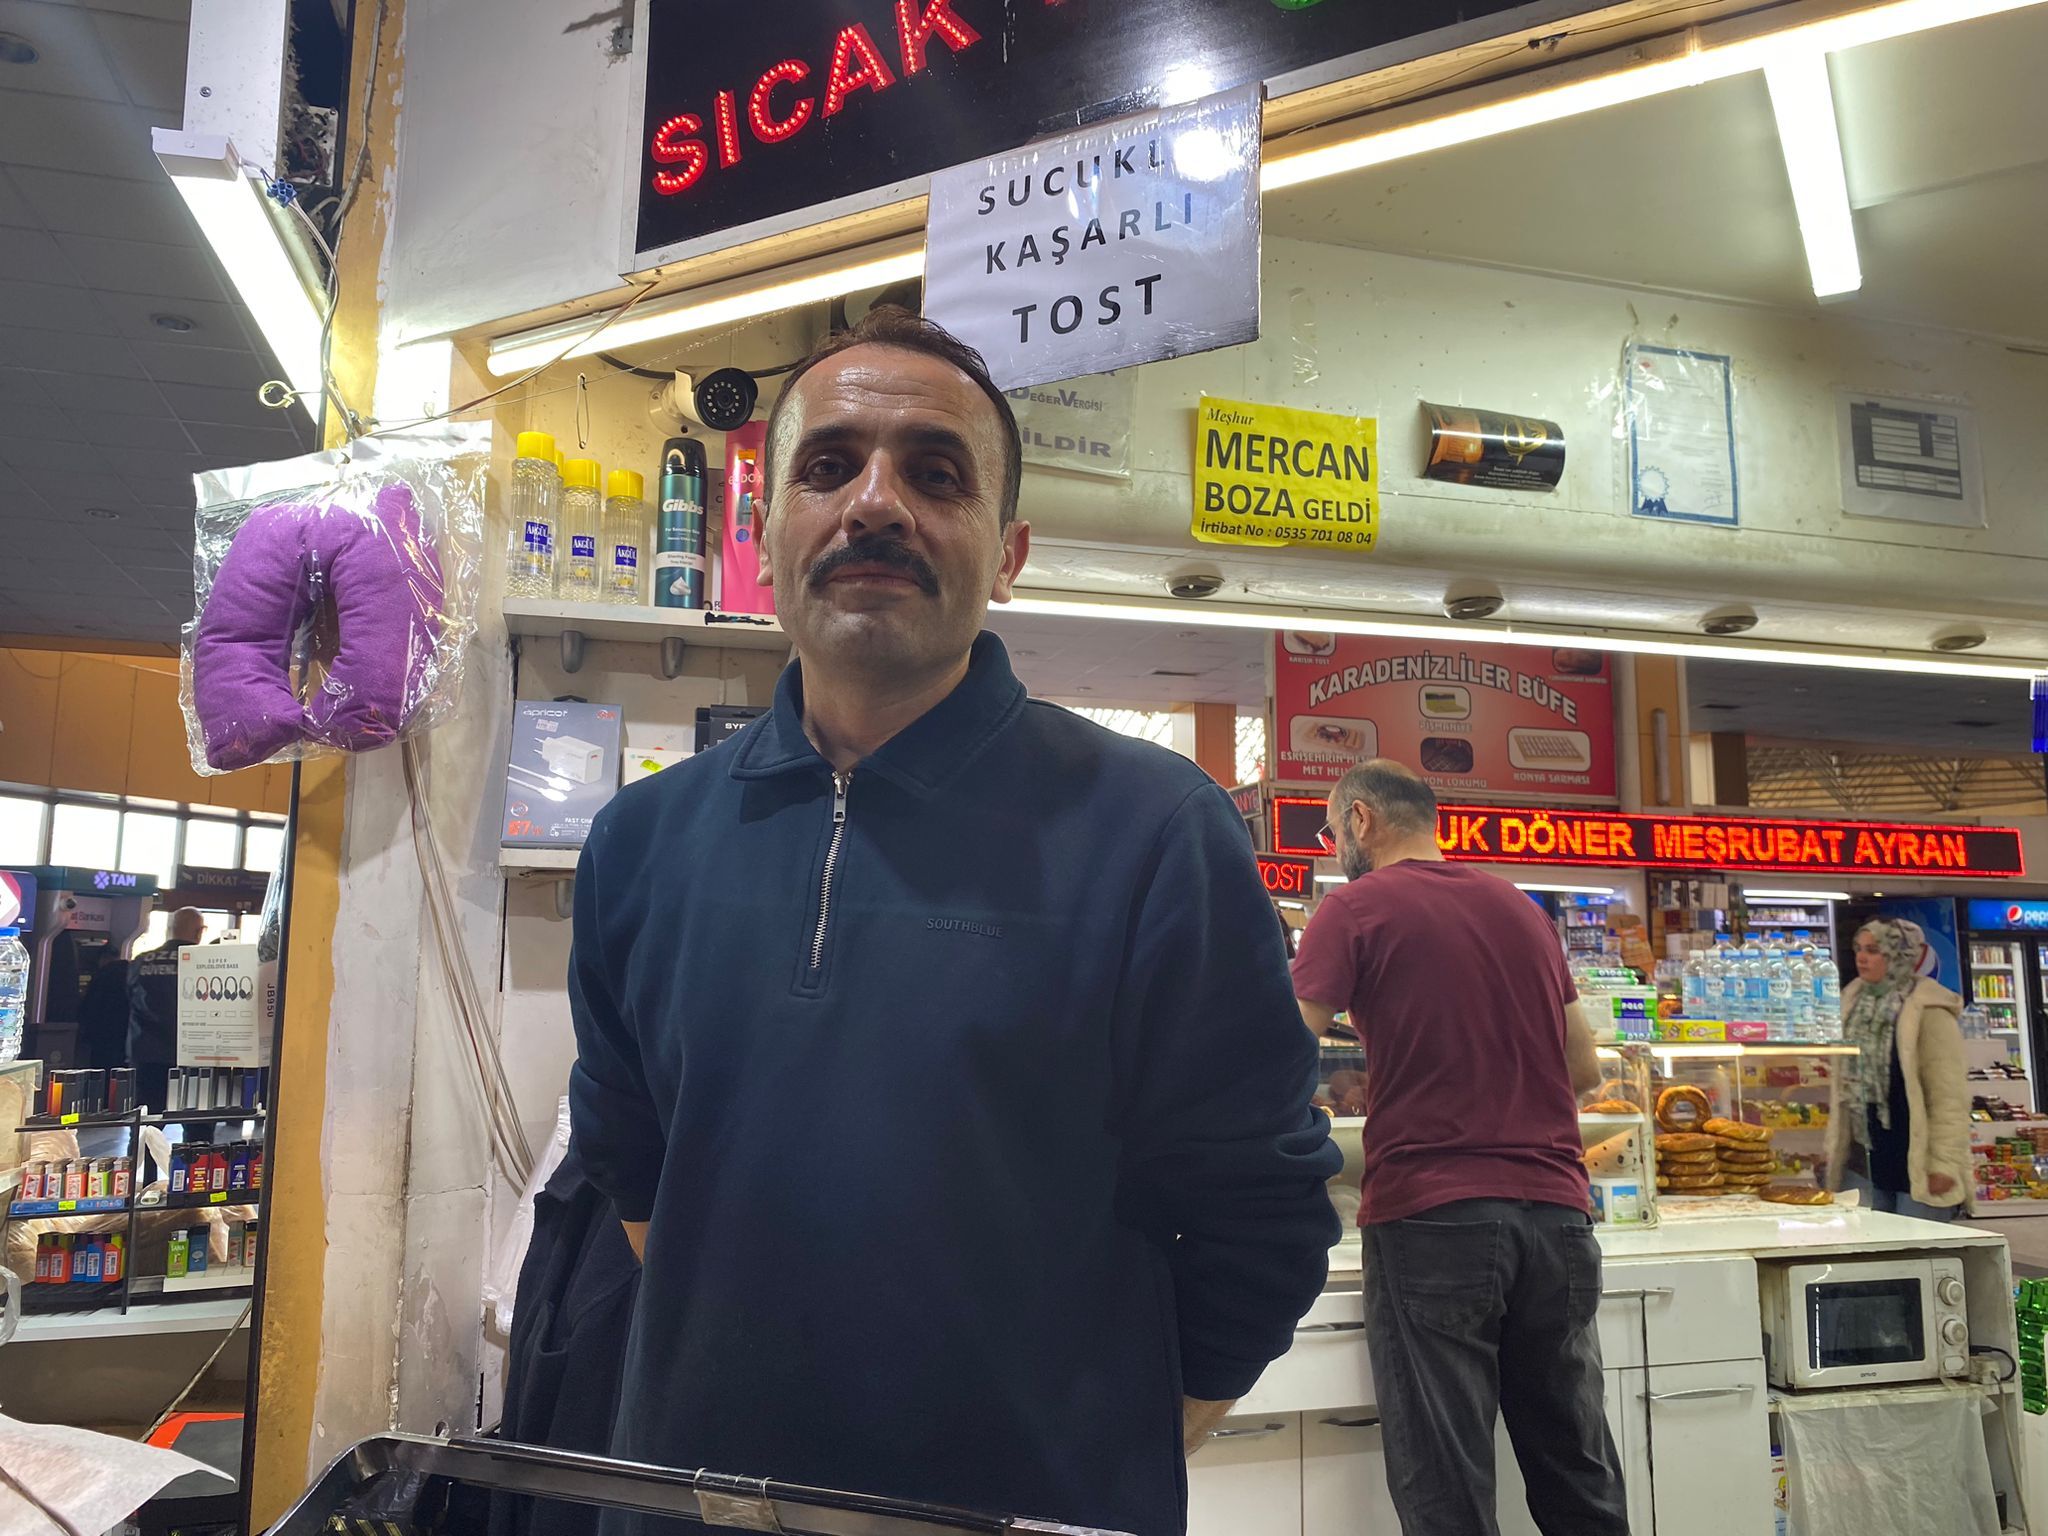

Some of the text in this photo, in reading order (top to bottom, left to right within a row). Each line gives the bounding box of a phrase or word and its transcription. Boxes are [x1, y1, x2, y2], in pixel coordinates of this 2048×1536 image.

[652, 0, 981, 195] SICAK
[978, 138, 1164, 216] SUCUKL
[986, 192, 1194, 274] KAŞARLI
[1013, 273, 1163, 344] TOST
[1206, 407, 1255, 426] Meşhur
[1206, 428, 1370, 482] MERCAN
[662, 498, 704, 515] Gibbs
[1204, 481, 1372, 524] BOZA GELDİ
[1201, 518, 1242, 536] İrtibat
[1245, 524, 1264, 537] No
[1275, 526, 1307, 540] 0535
[1310, 528, 1333, 542] 701
[1336, 530, 1353, 543] 08
[1355, 532, 1372, 545] 04
[1308, 650, 1579, 725] KARADENİZLİLER BÜFE
[1303, 765, 1323, 776] MET
[1500, 813, 1636, 858] DÖNER
[1653, 824, 1845, 864] MEŞRUBAT
[1854, 831, 1968, 867] AYRAN
[111, 873, 137, 888] TAM
[197, 872, 238, 887] DİKKAT
[926, 918, 1003, 938] SOUTHBLUE
[2024, 910, 2048, 928] pep
[1621, 1002, 1644, 1011] POLO
